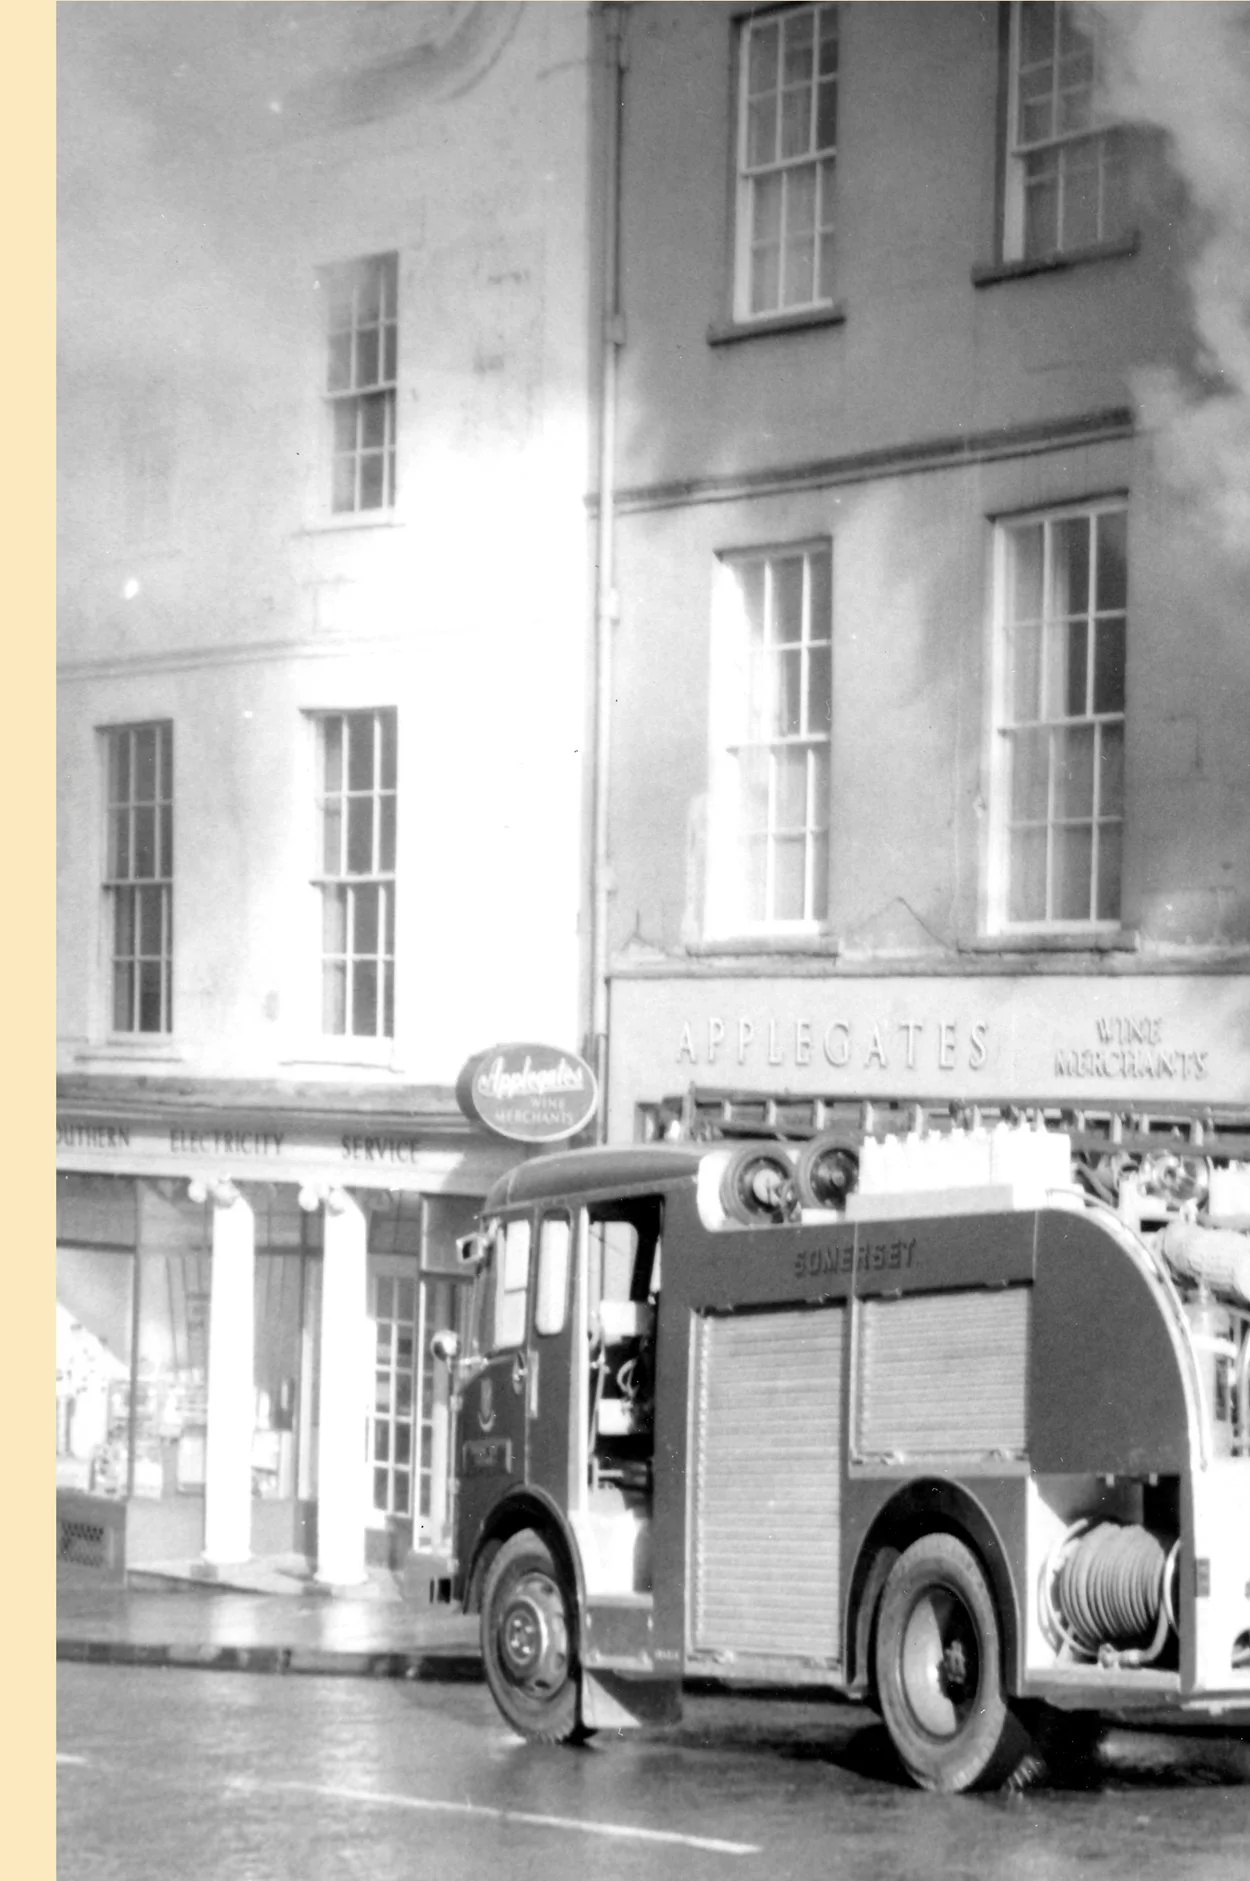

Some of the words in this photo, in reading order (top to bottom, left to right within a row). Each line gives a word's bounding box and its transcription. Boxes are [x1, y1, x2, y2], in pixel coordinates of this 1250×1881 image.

[675, 1016, 989, 1071] APPLEGATES
[1096, 1015, 1162, 1046] WINE
[478, 1055, 584, 1100] Applegates
[1054, 1049, 1209, 1081] MERCHANTS
[495, 1109, 574, 1125] MERCHANTS
[530, 1097, 566, 1109] WINE
[169, 1128, 284, 1156] ELECTRICITY
[341, 1133, 421, 1164] SERVICE
[794, 1237, 917, 1279] SOMERSET
